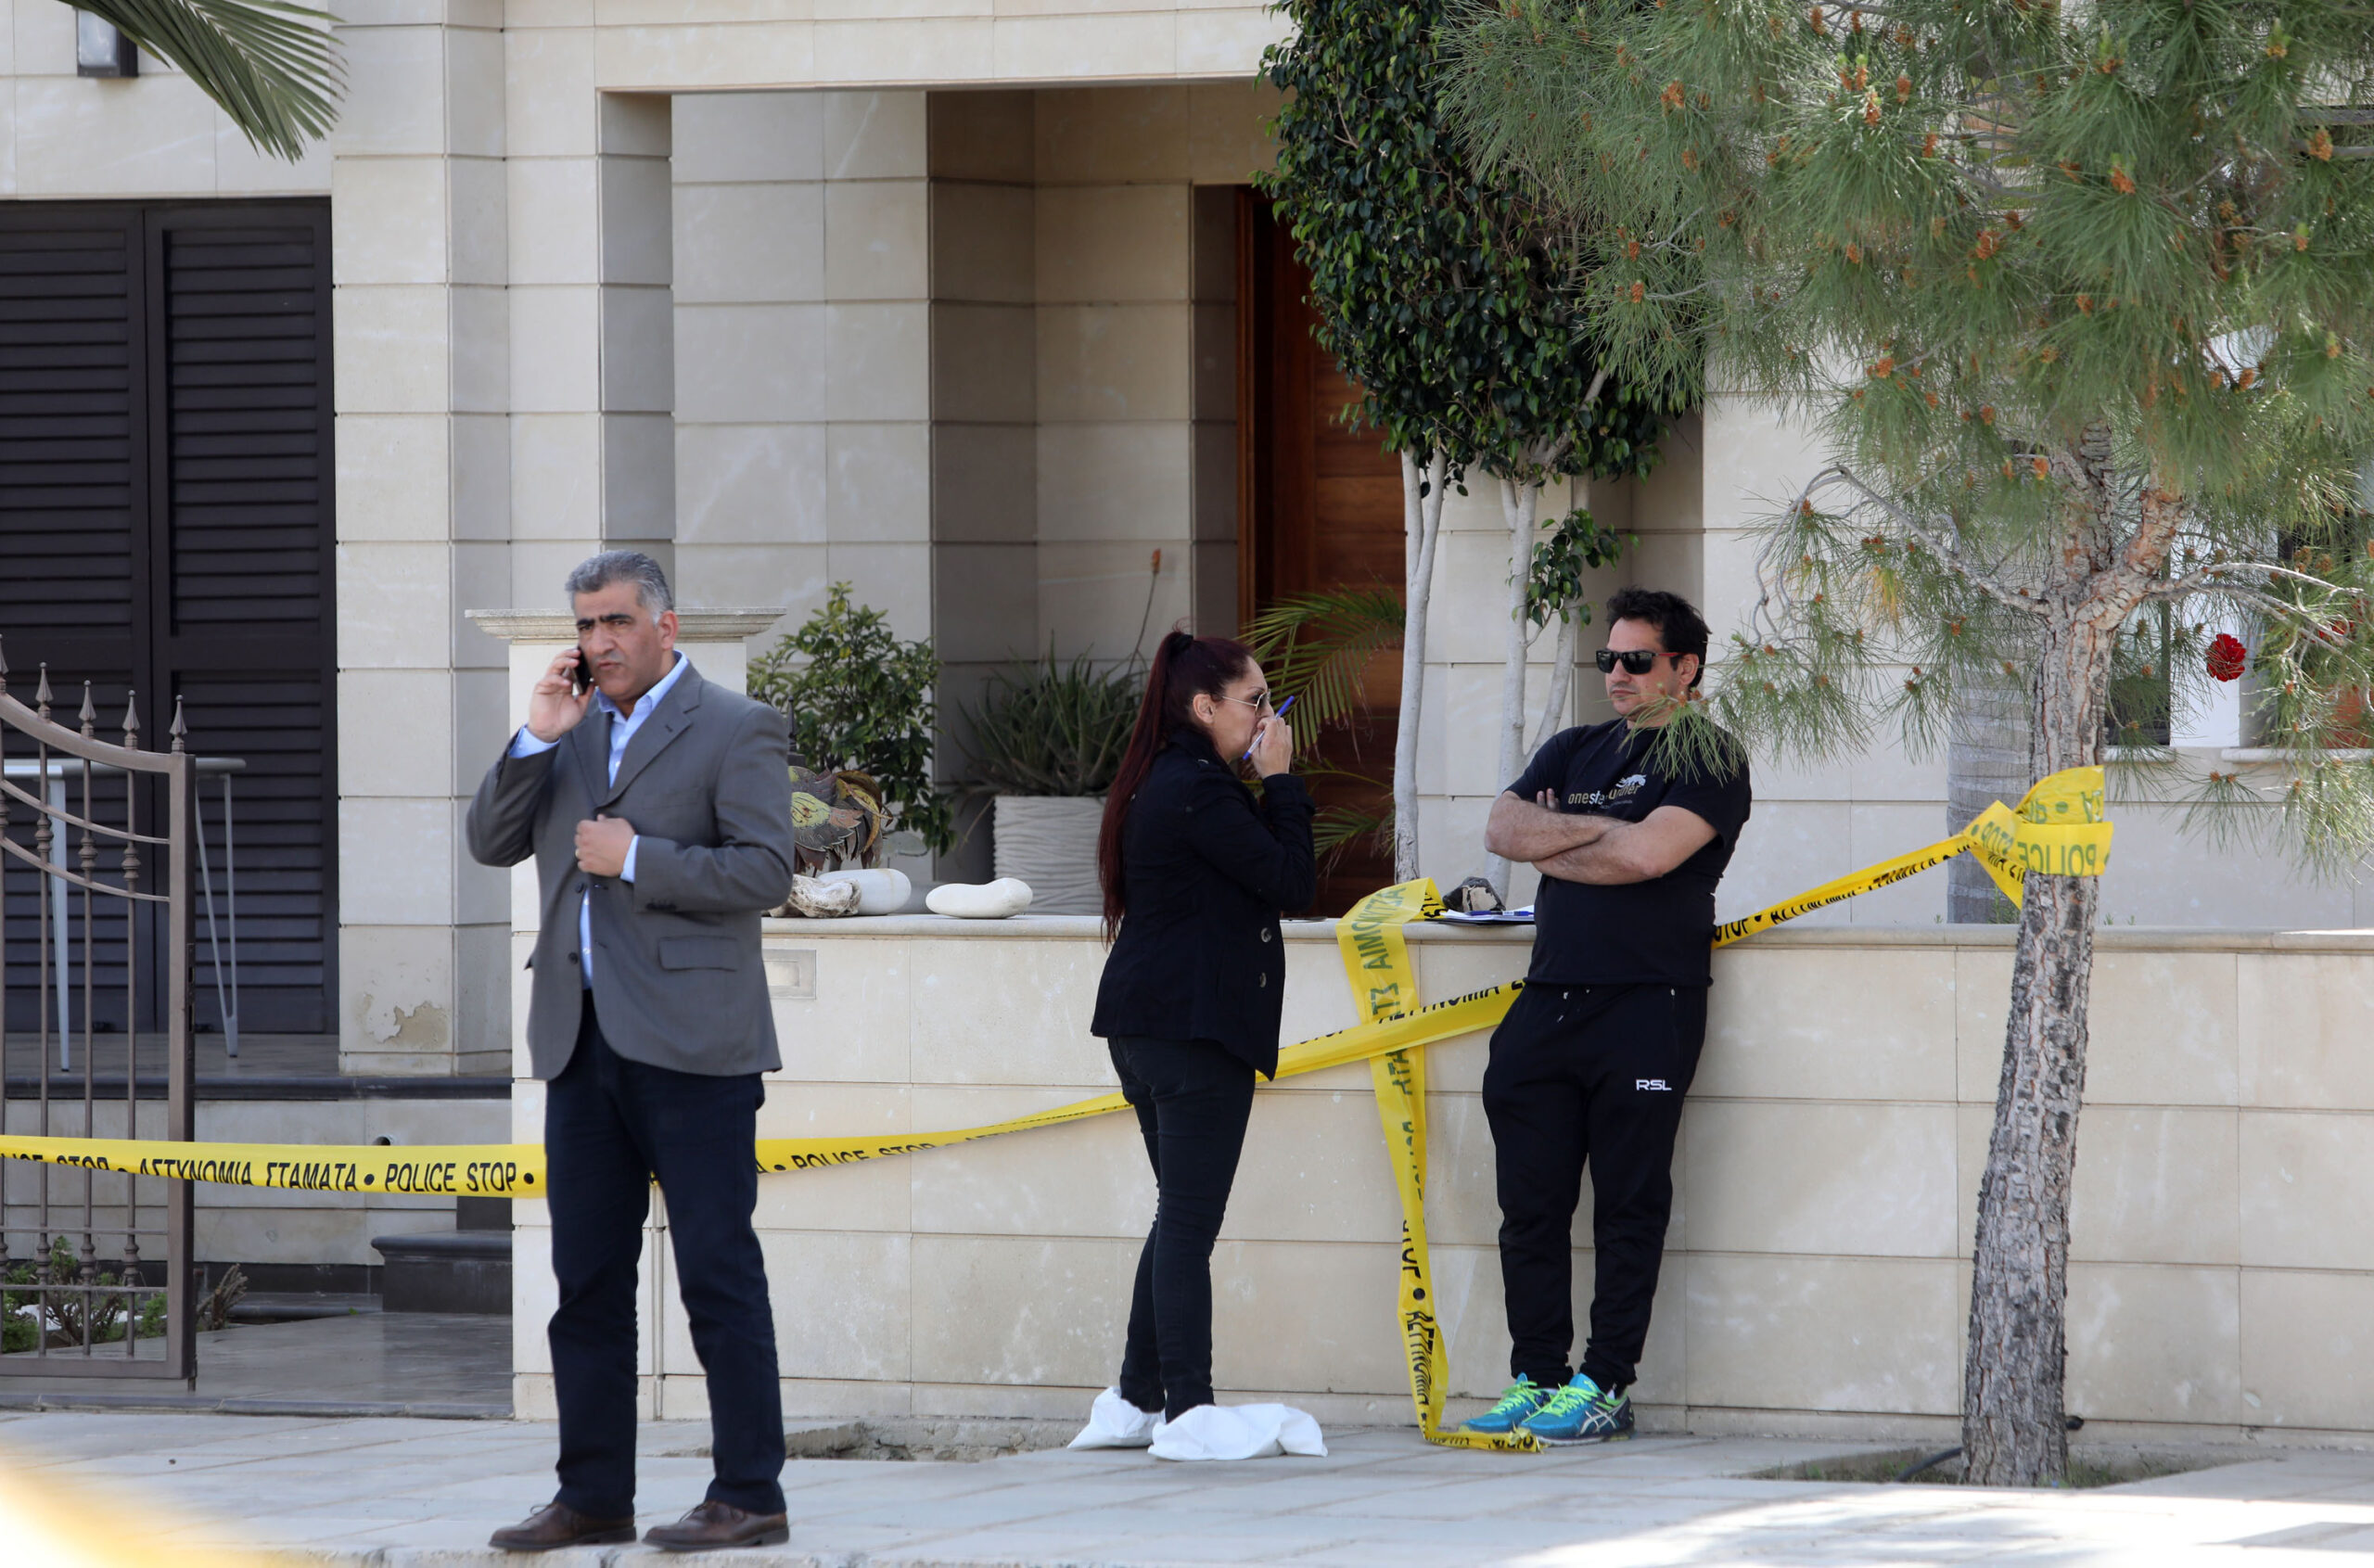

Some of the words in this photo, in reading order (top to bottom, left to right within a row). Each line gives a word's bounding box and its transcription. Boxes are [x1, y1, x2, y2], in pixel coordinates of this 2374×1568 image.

[1636, 1078, 1672, 1090] RSL
[267, 1163, 360, 1191] ΣΤΑΜΑΤΑ
[385, 1163, 457, 1192] POLICE
[466, 1162, 517, 1192] STOP
